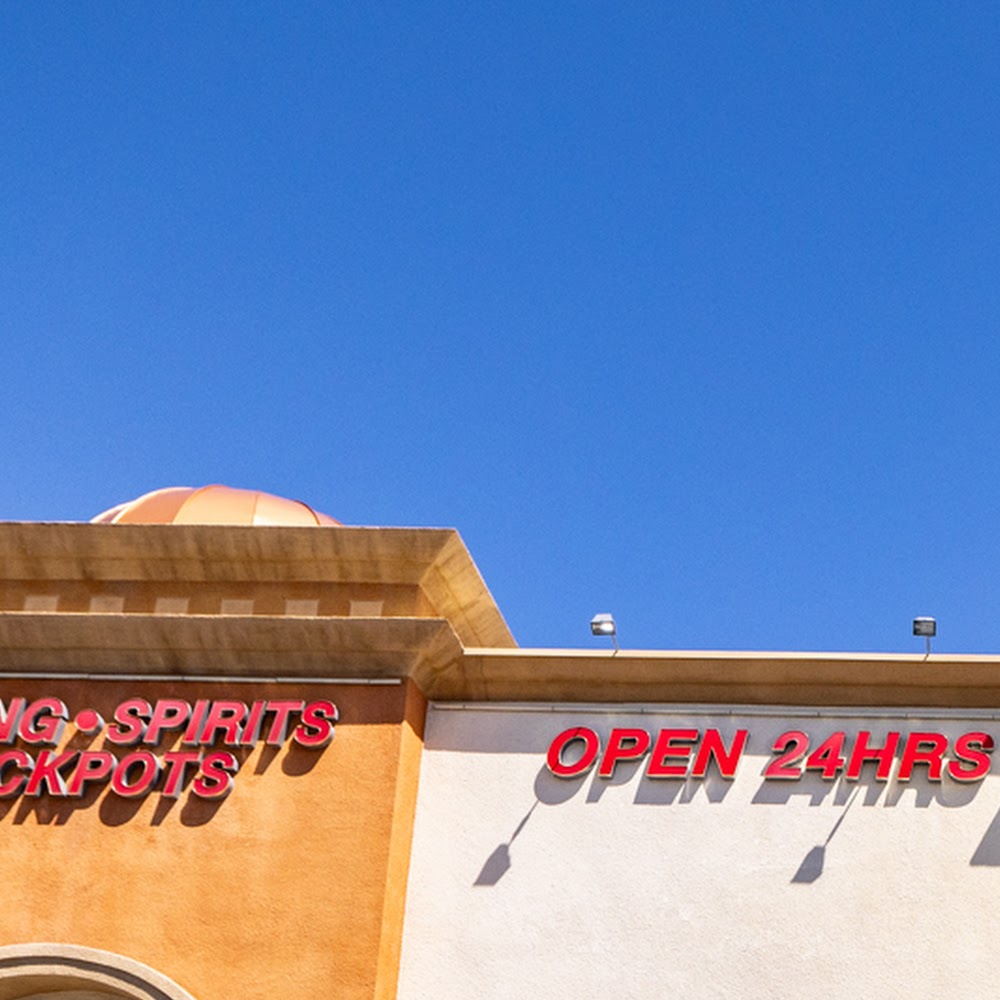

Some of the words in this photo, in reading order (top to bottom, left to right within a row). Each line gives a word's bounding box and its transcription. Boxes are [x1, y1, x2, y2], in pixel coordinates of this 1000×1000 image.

[106, 697, 338, 748] SPIRITS
[0, 750, 239, 797] CKPOTS
[546, 727, 749, 778] OPEN
[764, 730, 995, 782] 24HRS
